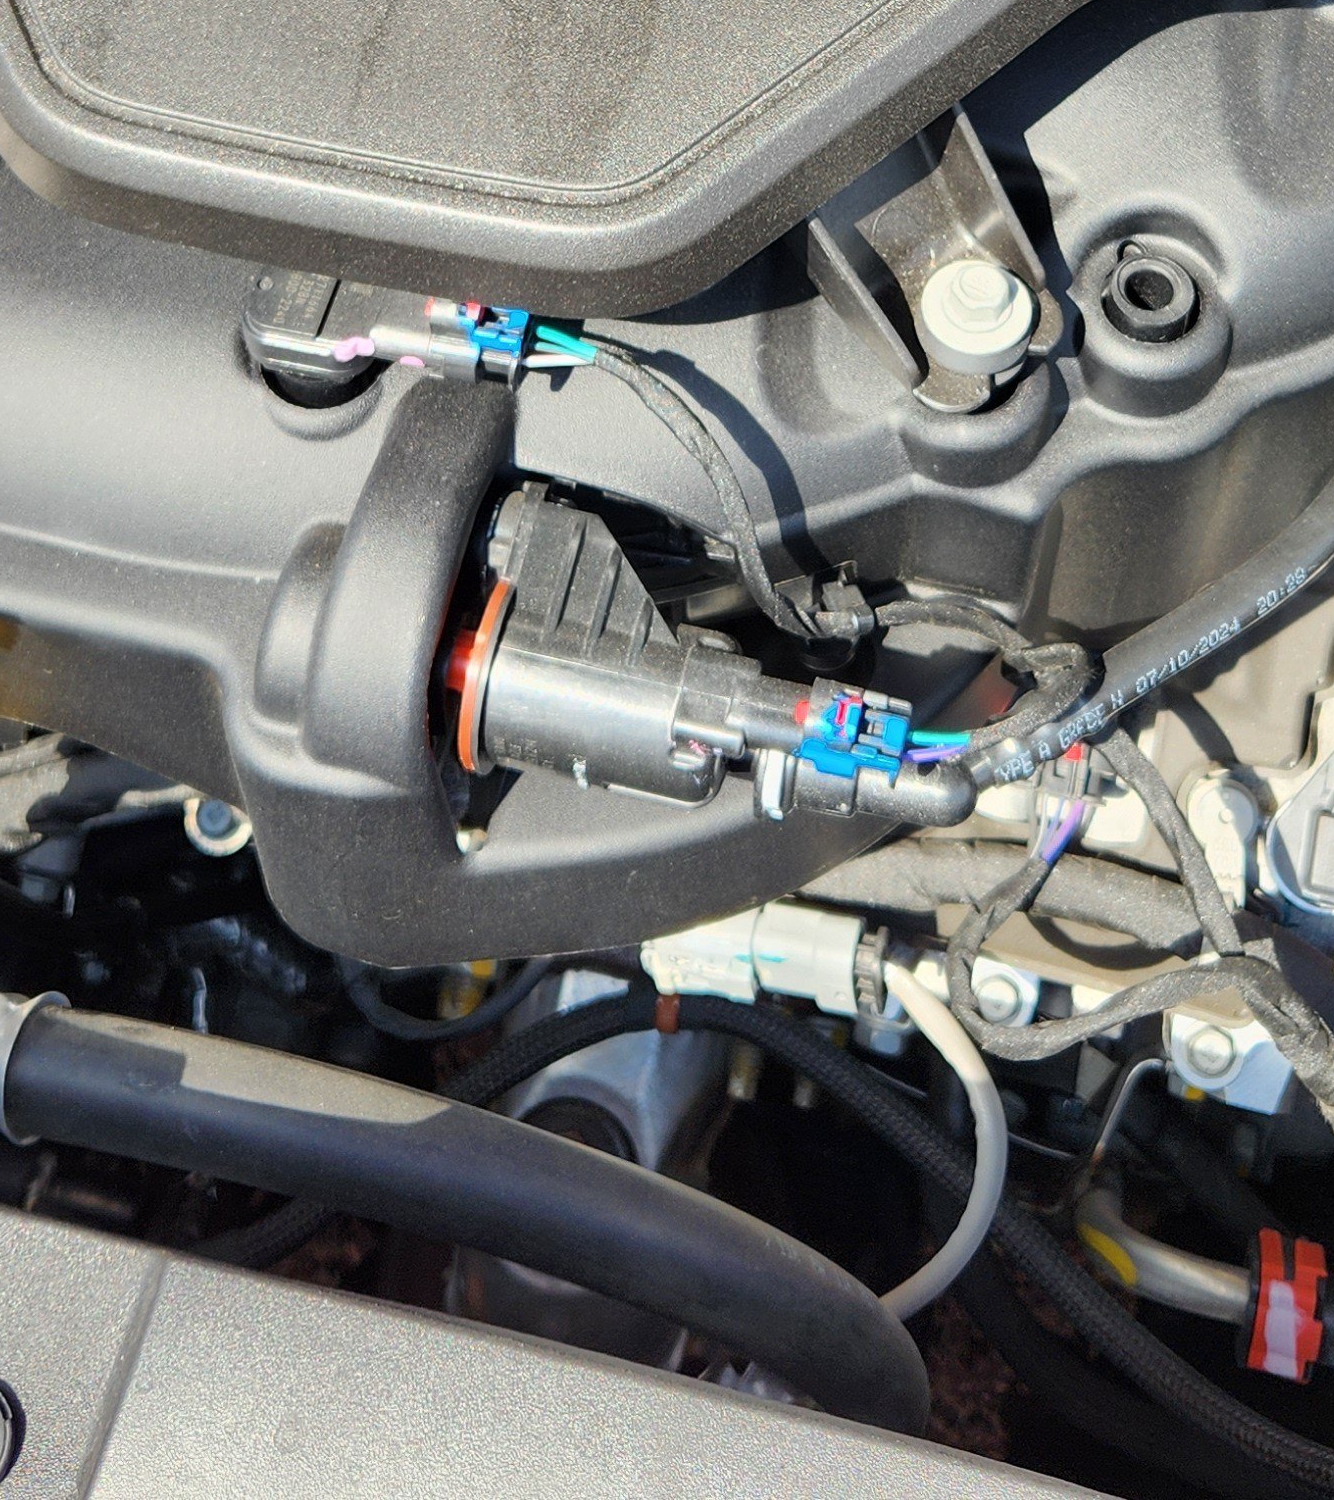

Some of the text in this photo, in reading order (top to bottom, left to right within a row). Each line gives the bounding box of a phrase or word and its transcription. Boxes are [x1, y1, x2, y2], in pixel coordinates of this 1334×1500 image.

[1035, 739, 1051, 760] A
[1056, 703, 1105, 749] GRADE
[1136, 615, 1241, 694] 07/10/2024
[1256, 567, 1309, 616] 20:28
